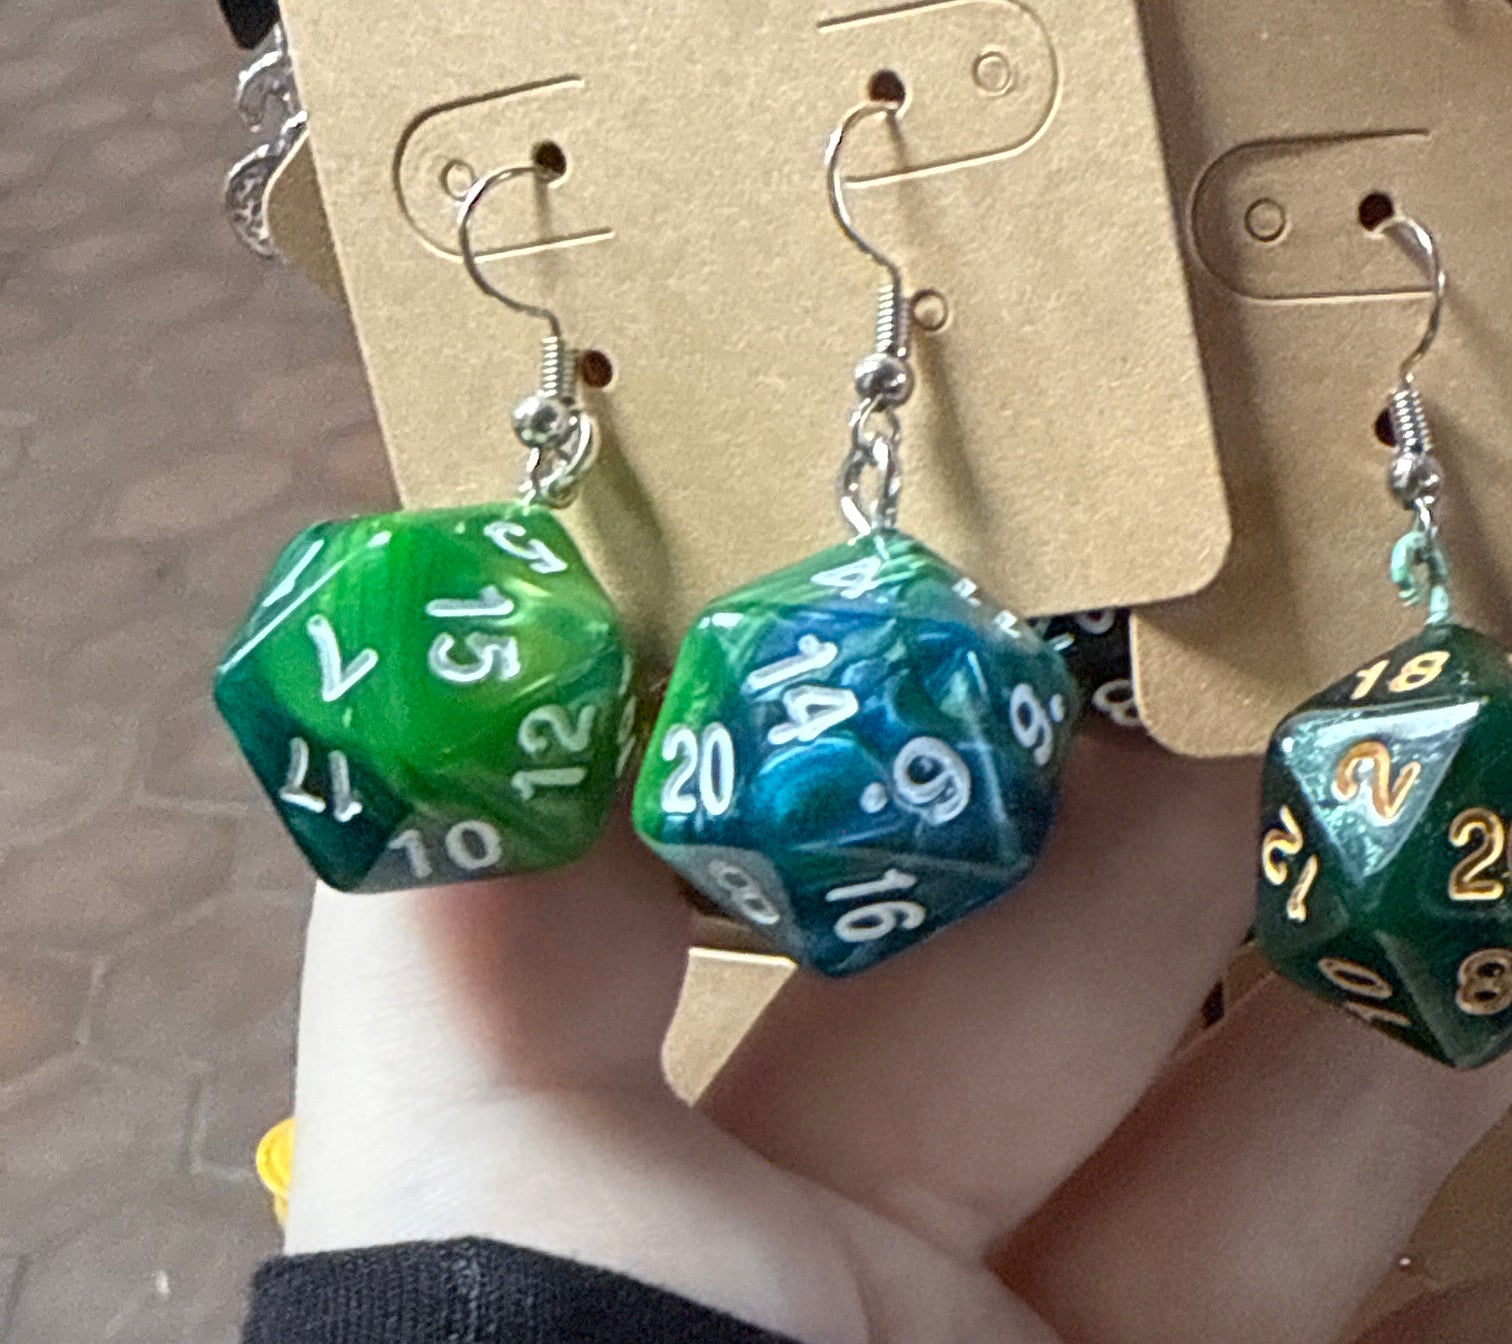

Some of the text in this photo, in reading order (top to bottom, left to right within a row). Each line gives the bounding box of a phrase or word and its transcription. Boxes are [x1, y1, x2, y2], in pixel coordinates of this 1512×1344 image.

[307, 613, 379, 702] 7
[424, 585, 521, 683] 15
[1350, 651, 1451, 700] 18
[742, 635, 859, 745] 14
[511, 704, 596, 802] 12
[660, 722, 735, 816] 20
[1332, 741, 1421, 826] 2
[387, 819, 502, 878] 10
